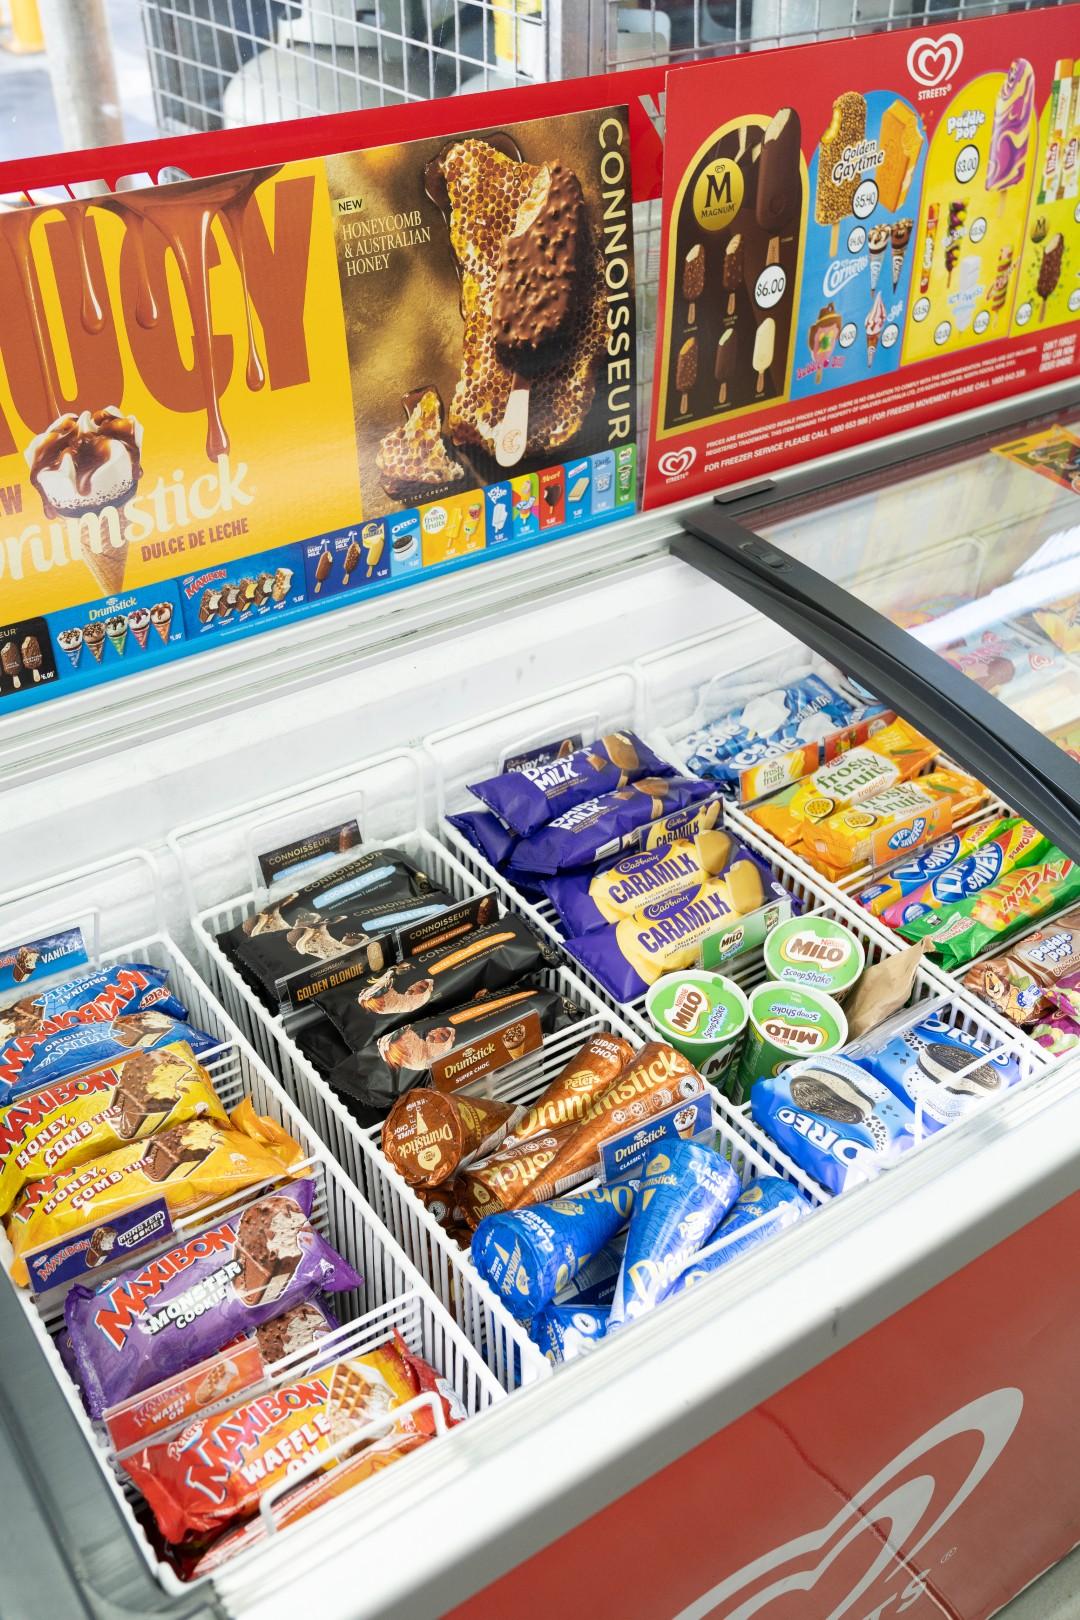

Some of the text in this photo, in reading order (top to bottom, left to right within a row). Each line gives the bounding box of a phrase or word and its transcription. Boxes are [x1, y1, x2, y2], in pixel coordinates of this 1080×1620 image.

[833, 151, 884, 183] Gaytime
[843, 141, 876, 163] Golden
[338, 199, 362, 213] NEW
[702, 203, 735, 218] MAGNUM
[342, 210, 421, 241] HONEYCOMB
[344, 226, 431, 259] & AUSTRALIAN
[346, 252, 391, 277] HONEY
[598, 117, 631, 443] CONNOISSEUR
[757, 276, 784, 297] $6.00
[704, 460, 719, 473] FOR
[720, 450, 752, 468] FREEZER
[754, 441, 782, 458] SERVICE
[784, 433, 810, 449] PLEASE
[811, 427, 828, 441] CALL
[0, 453, 255, 581] rumstick
[142, 517, 249, 562] DULCE DE LECHE
[88, 596, 138, 621] Drumstick
[533, 763, 580, 792] MILK
[762, 773, 785, 786] fruits
[763, 765, 784, 779] frosty
[816, 754, 878, 790] frosty
[832, 763, 893, 797] fruits
[560, 804, 608, 831] MILK
[901, 818, 926, 847] SAVERS
[656, 820, 699, 847] CARAMILK
[268, 837, 331, 866] CONNOISSEUR
[619, 853, 660, 873] Cadbury
[304, 851, 383, 893] CONNOISSEUR
[608, 852, 700, 904] CARAMILK
[935, 861, 970, 895] LIFE
[353, 893, 436, 917] CONNOISSEUR
[648, 894, 690, 917] Cadbury
[409, 910, 468, 940] CONNOISSEUR
[637, 891, 732, 953] CARAMILK
[41, 941, 82, 964] VANILLA
[720, 931, 743, 948] MILO
[790, 938, 844, 963] MILO
[58, 976, 108, 1003] ORIGINAL
[297, 962, 364, 1001] GOLDEN BLONDIE
[671, 991, 703, 1031] MILO
[44, 1029, 96, 1052] ORIGINAL
[765, 1023, 819, 1046] MILO
[444, 1042, 497, 1079] Drumstick
[455, 1061, 490, 1084] SUPER CHOC
[564, 1071, 600, 1091] Peters
[44, 1104, 122, 1166] COMB THIS
[396, 1123, 454, 1159] Drumstick
[614, 1125, 668, 1163] Drumstick
[619, 1156, 641, 1171] CLASSIC
[71, 1171, 123, 1209] COMB
[123, 1156, 154, 1174] THIS
[118, 1212, 165, 1244] MONSTER
[126, 1219, 161, 1246] COOKIE
[37, 1240, 92, 1282] MAXIBON
[95, 1224, 240, 1351] MAXIBON
[148, 1259, 244, 1336] MONSTER
[175, 1289, 228, 1330] COOKIE
[151, 1392, 193, 1424] WAFFLE
[168, 1407, 185, 1421] ON
[168, 1418, 208, 1461] Peters
[186, 1379, 330, 1504] MAXIBON
[241, 1412, 332, 1485] WAFFLE
